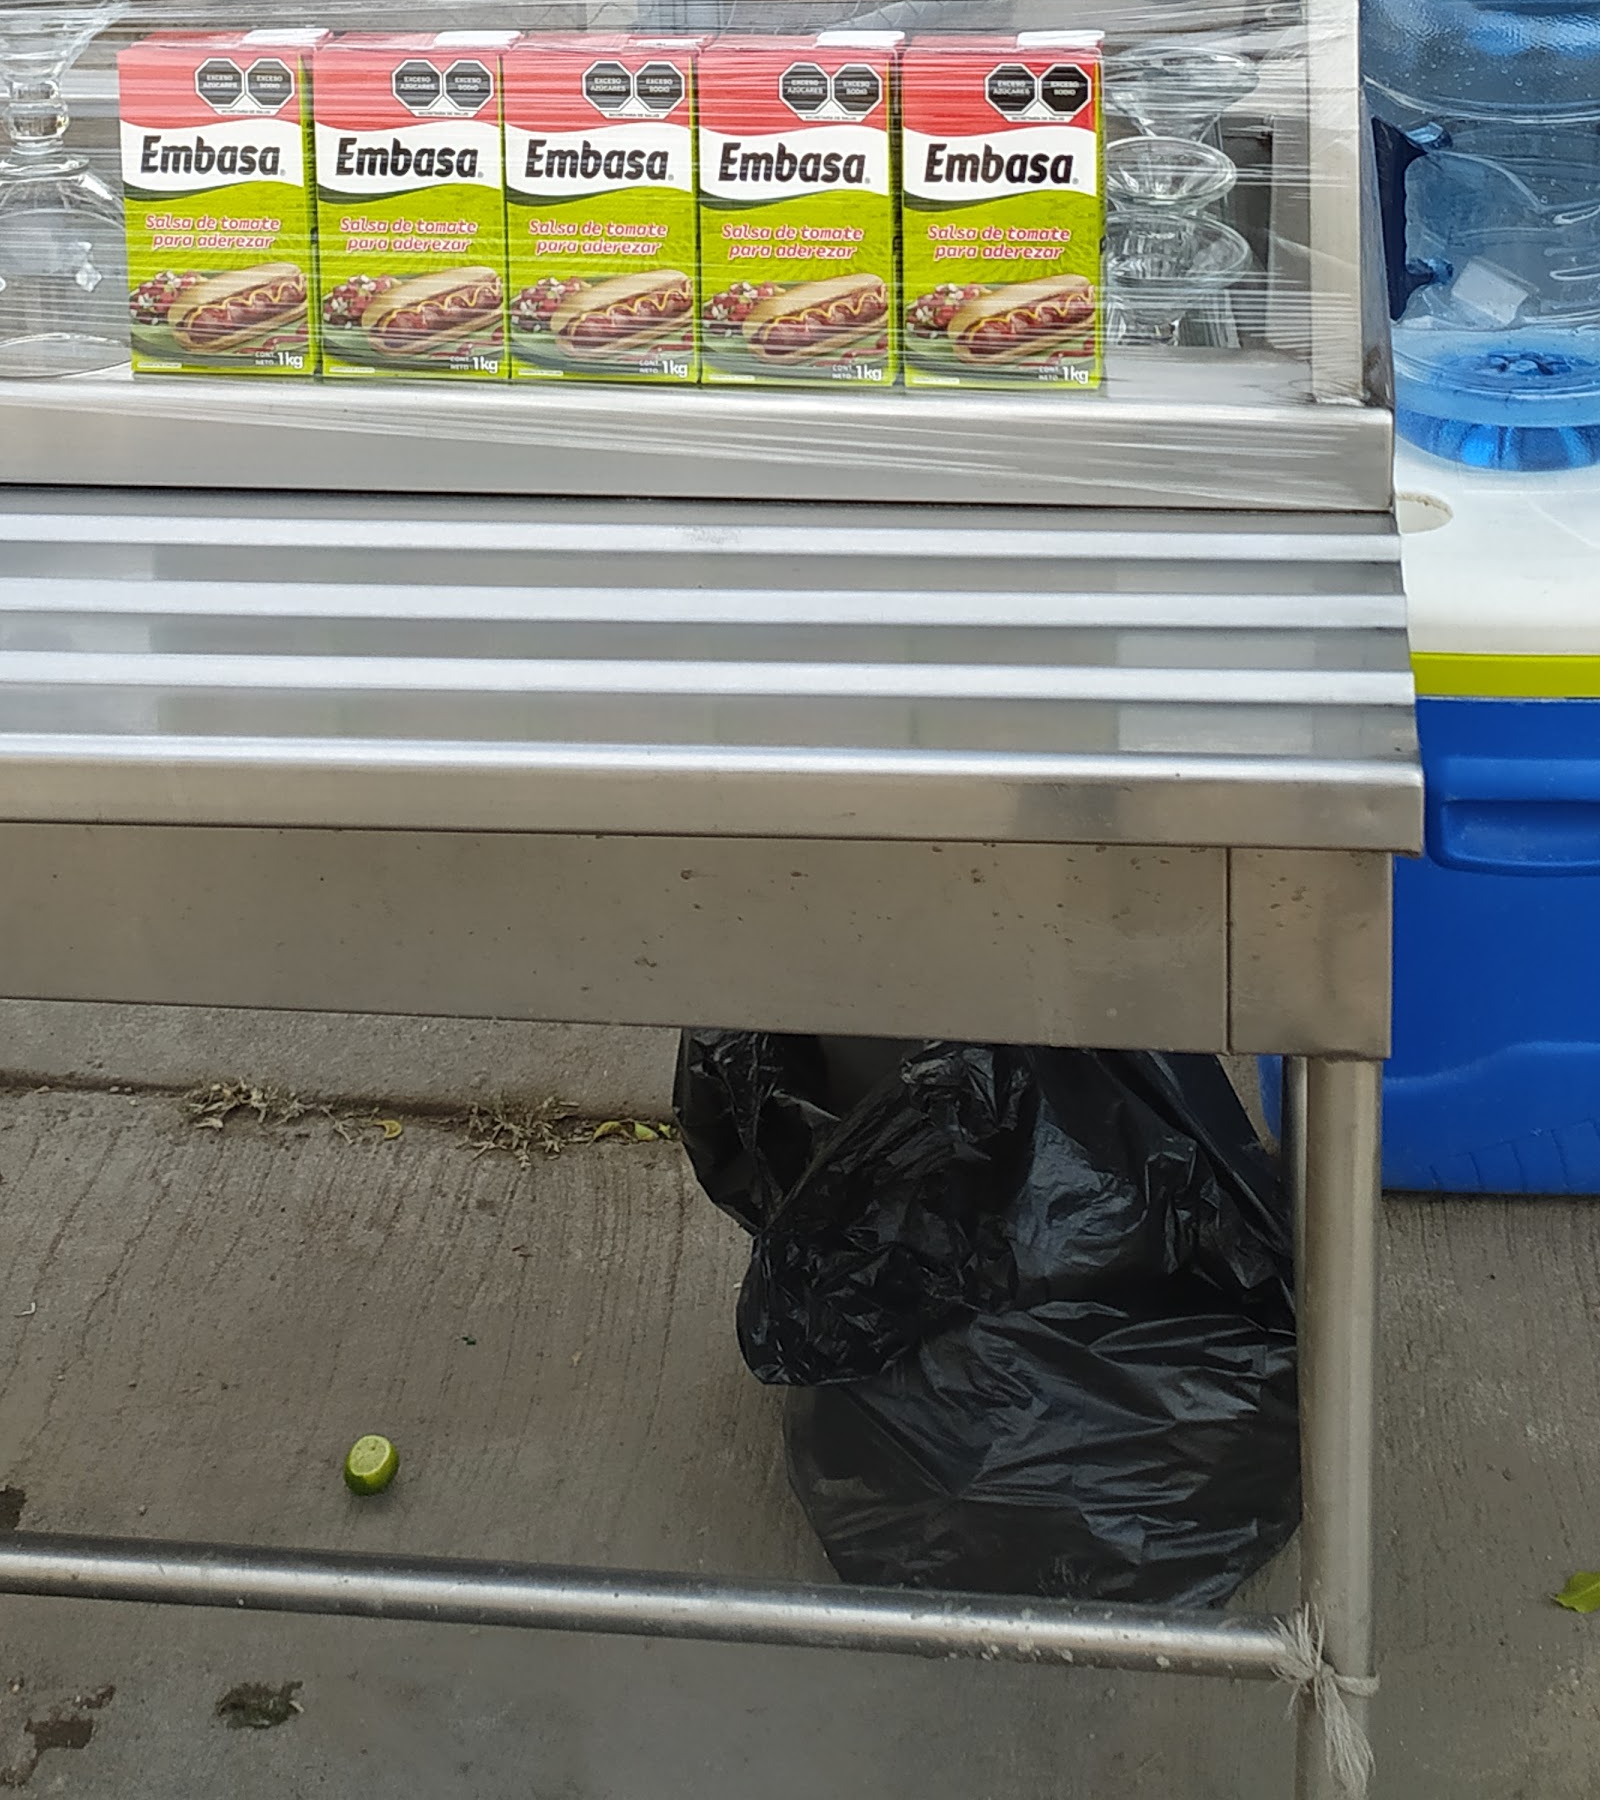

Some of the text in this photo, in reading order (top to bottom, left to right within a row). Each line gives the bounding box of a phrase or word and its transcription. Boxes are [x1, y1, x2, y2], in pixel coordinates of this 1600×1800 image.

[141, 135, 281, 175] Embasa
[335, 137, 479, 178] Embasa
[525, 139, 669, 181] Embasa
[718, 142, 866, 184] Embasa
[924, 143, 1074, 184] Embasa
[146, 215, 281, 232] Salsa de tomate
[340, 218, 478, 235] Salsa de tomate
[529, 220, 667, 237] Salsa de tomate
[722, 224, 863, 241] Salsa de tomate
[153, 234, 276, 249] para aderezar
[928, 224, 1070, 242] Salsa de tomate
[346, 237, 471, 252] para aderezar
[536, 239, 661, 255] para aderezar
[729, 244, 857, 260] para aderezar
[935, 244, 1064, 261] para aderezar
[277, 351, 304, 369] 1kg
[472, 356, 498, 374] 1kg
[662, 360, 688, 378] 1kg
[855, 364, 882, 382] 1kg
[1062, 365, 1089, 384] 1kg
